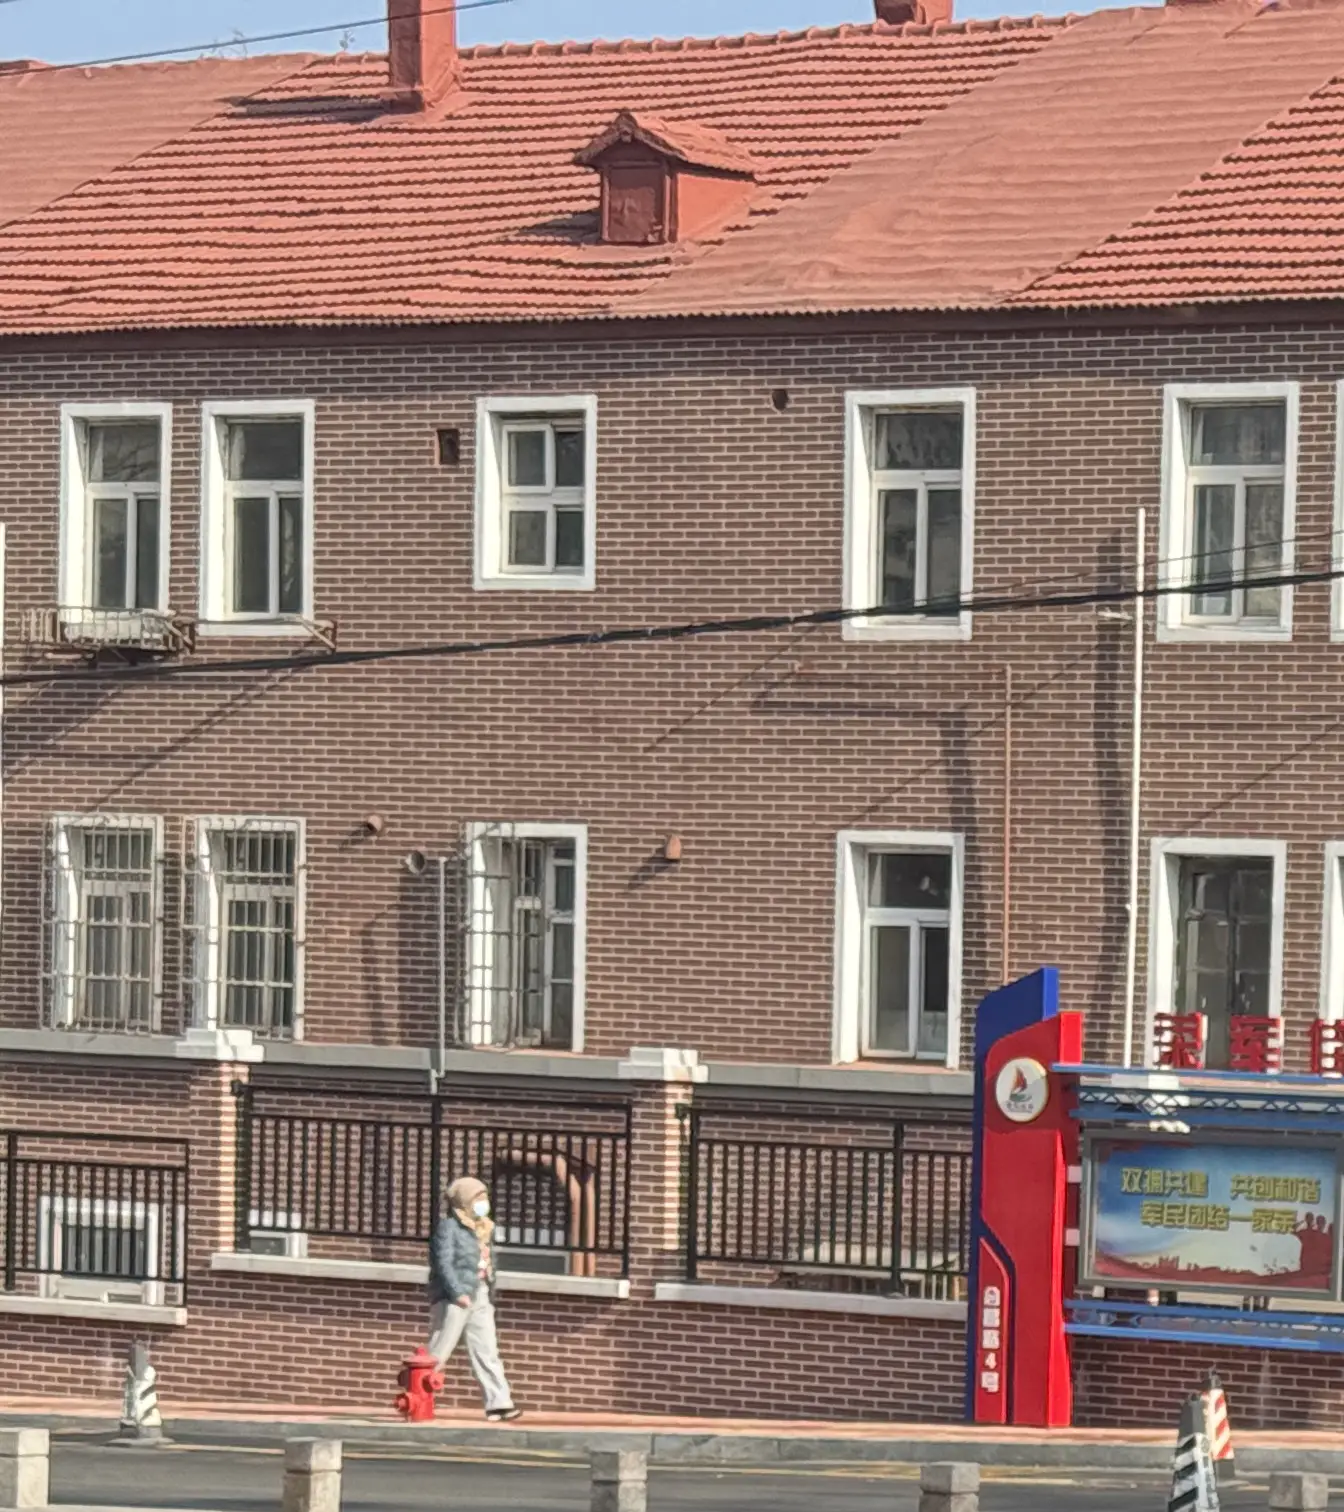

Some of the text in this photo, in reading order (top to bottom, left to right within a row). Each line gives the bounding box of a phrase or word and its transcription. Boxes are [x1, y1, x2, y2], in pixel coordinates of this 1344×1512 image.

[1121, 1167, 1320, 1203] 双拥共建 共创和谐
[1141, 1201, 1298, 1234] 军民团结一家亲
